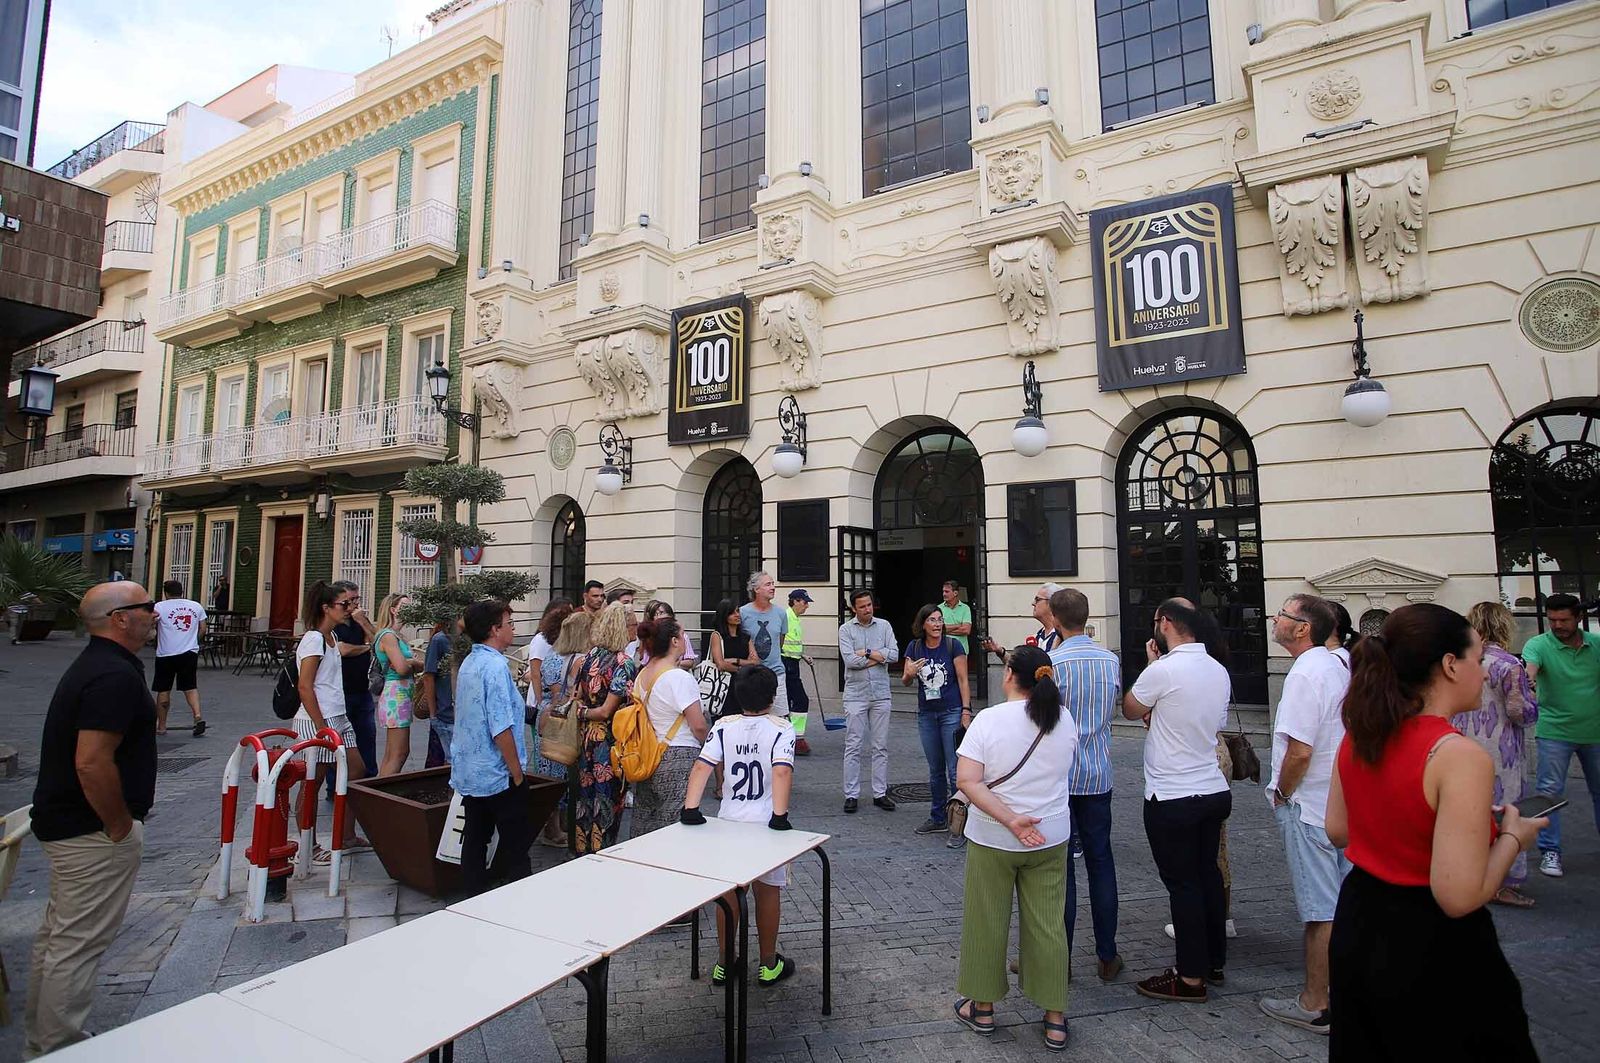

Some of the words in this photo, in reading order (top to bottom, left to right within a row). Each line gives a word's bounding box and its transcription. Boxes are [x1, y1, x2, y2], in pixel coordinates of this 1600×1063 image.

[1126, 244, 1200, 311] 100
[1133, 302, 1200, 324] ANIVERSARIO
[1144, 317, 1190, 331] 1923-2023
[688, 338, 730, 386] 100
[1133, 364, 1166, 376] Huelva
[690, 382, 728, 396] ANIVERSARIO
[695, 393, 722, 402] 1923-2023
[687, 427, 706, 435] Huelva
[731, 760, 764, 801] 20
